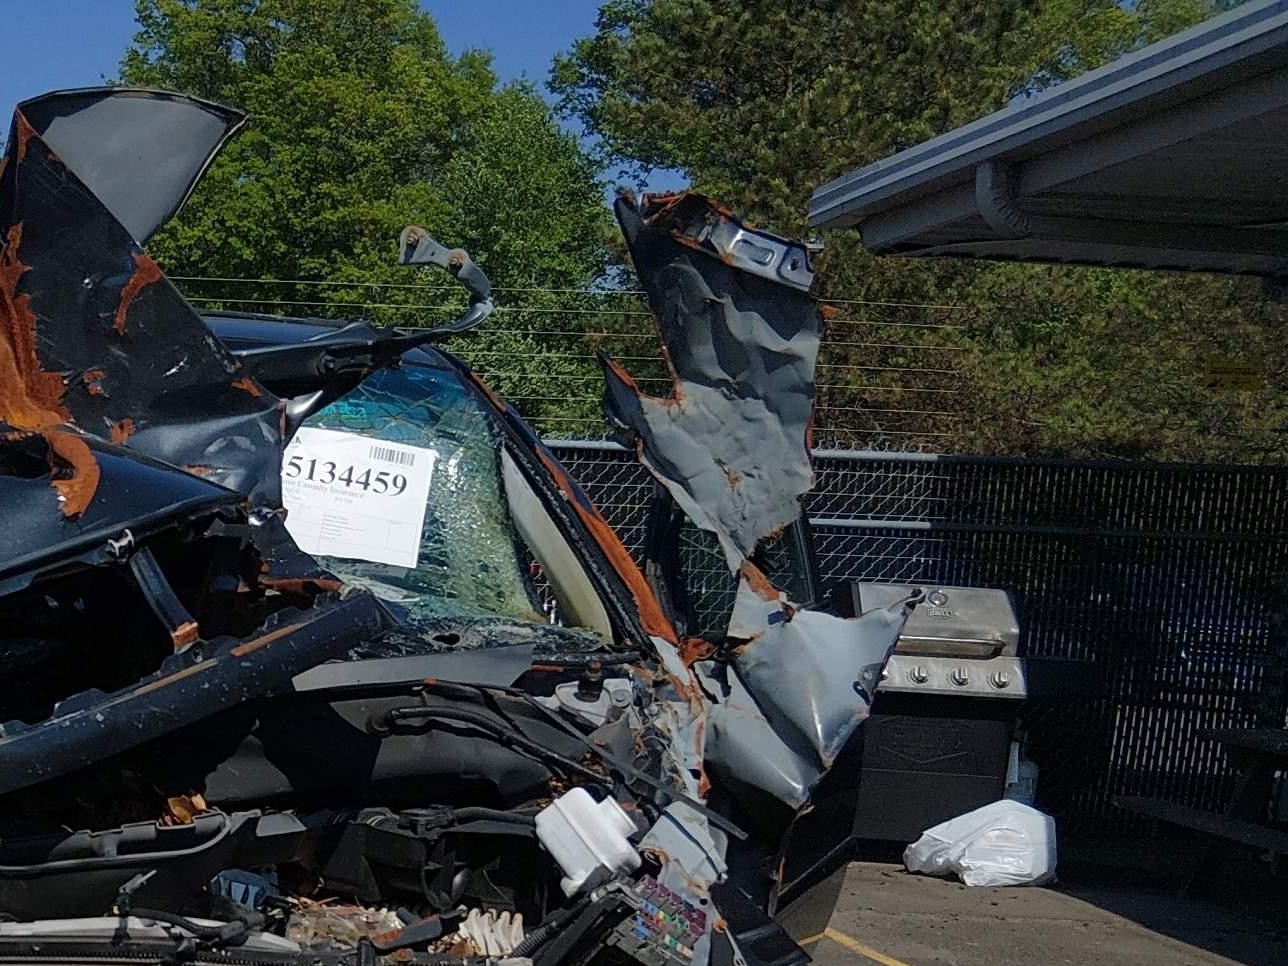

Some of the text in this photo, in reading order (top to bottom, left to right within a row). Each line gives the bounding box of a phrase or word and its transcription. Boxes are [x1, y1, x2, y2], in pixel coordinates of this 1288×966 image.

[285, 455, 408, 497] 5134459
[297, 479, 328, 493] Casualty
[330, 486, 365, 498] Insurance
